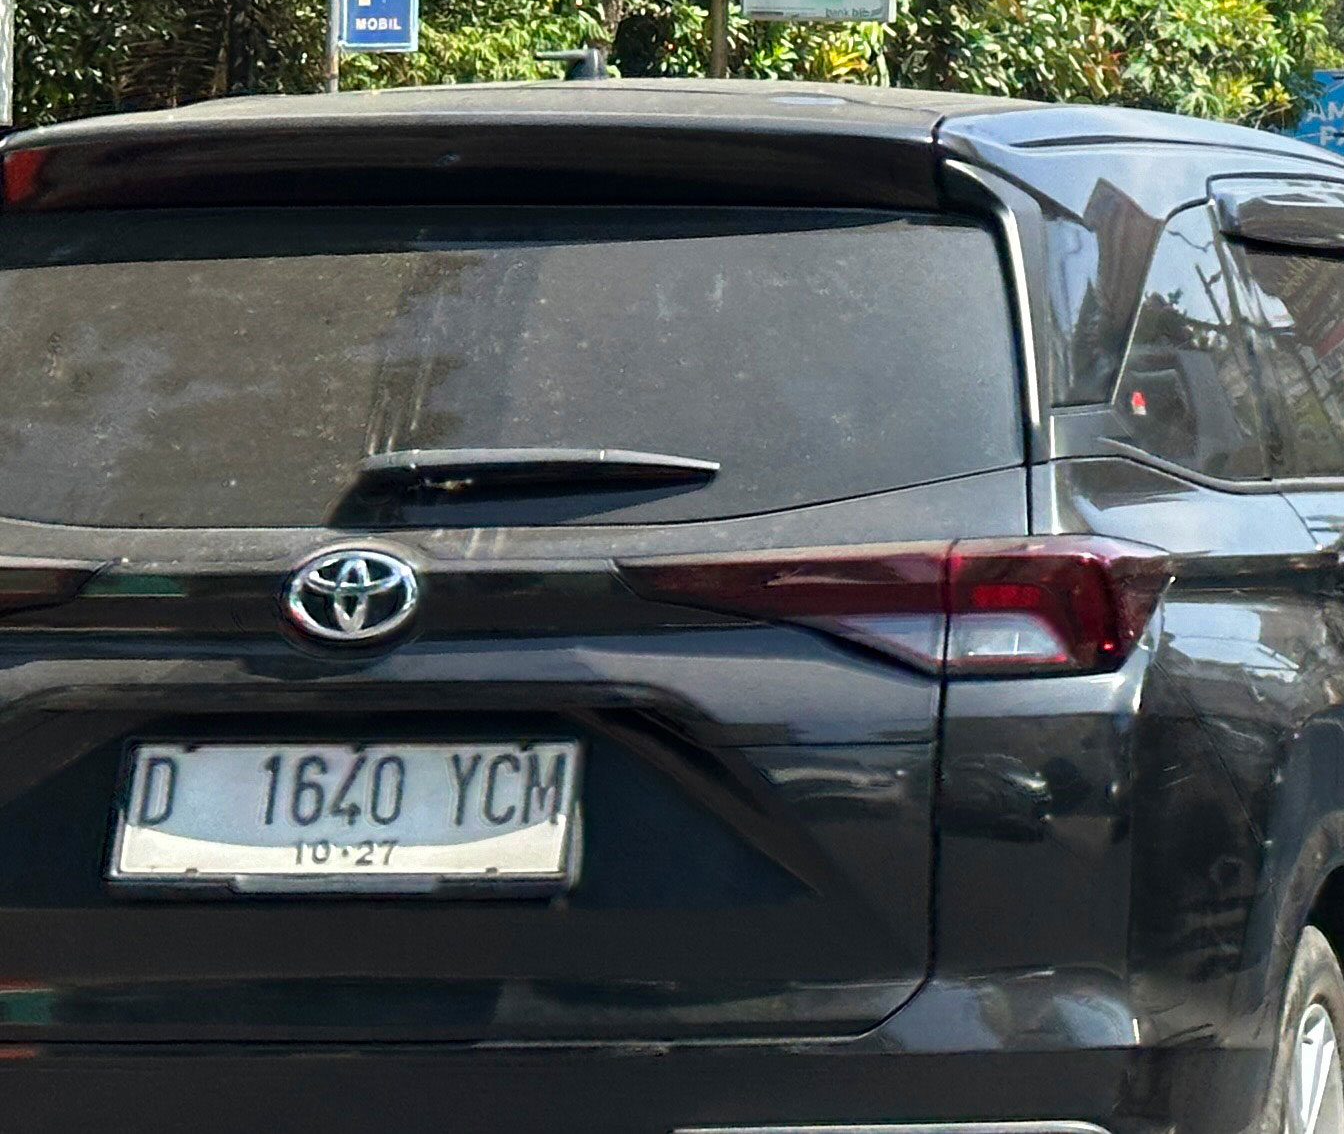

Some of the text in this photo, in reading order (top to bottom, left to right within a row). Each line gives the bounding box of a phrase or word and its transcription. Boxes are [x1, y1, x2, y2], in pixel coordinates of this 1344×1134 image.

[355, 18, 402, 31] MOBIL
[139, 753, 566, 827] D 1640 YCM
